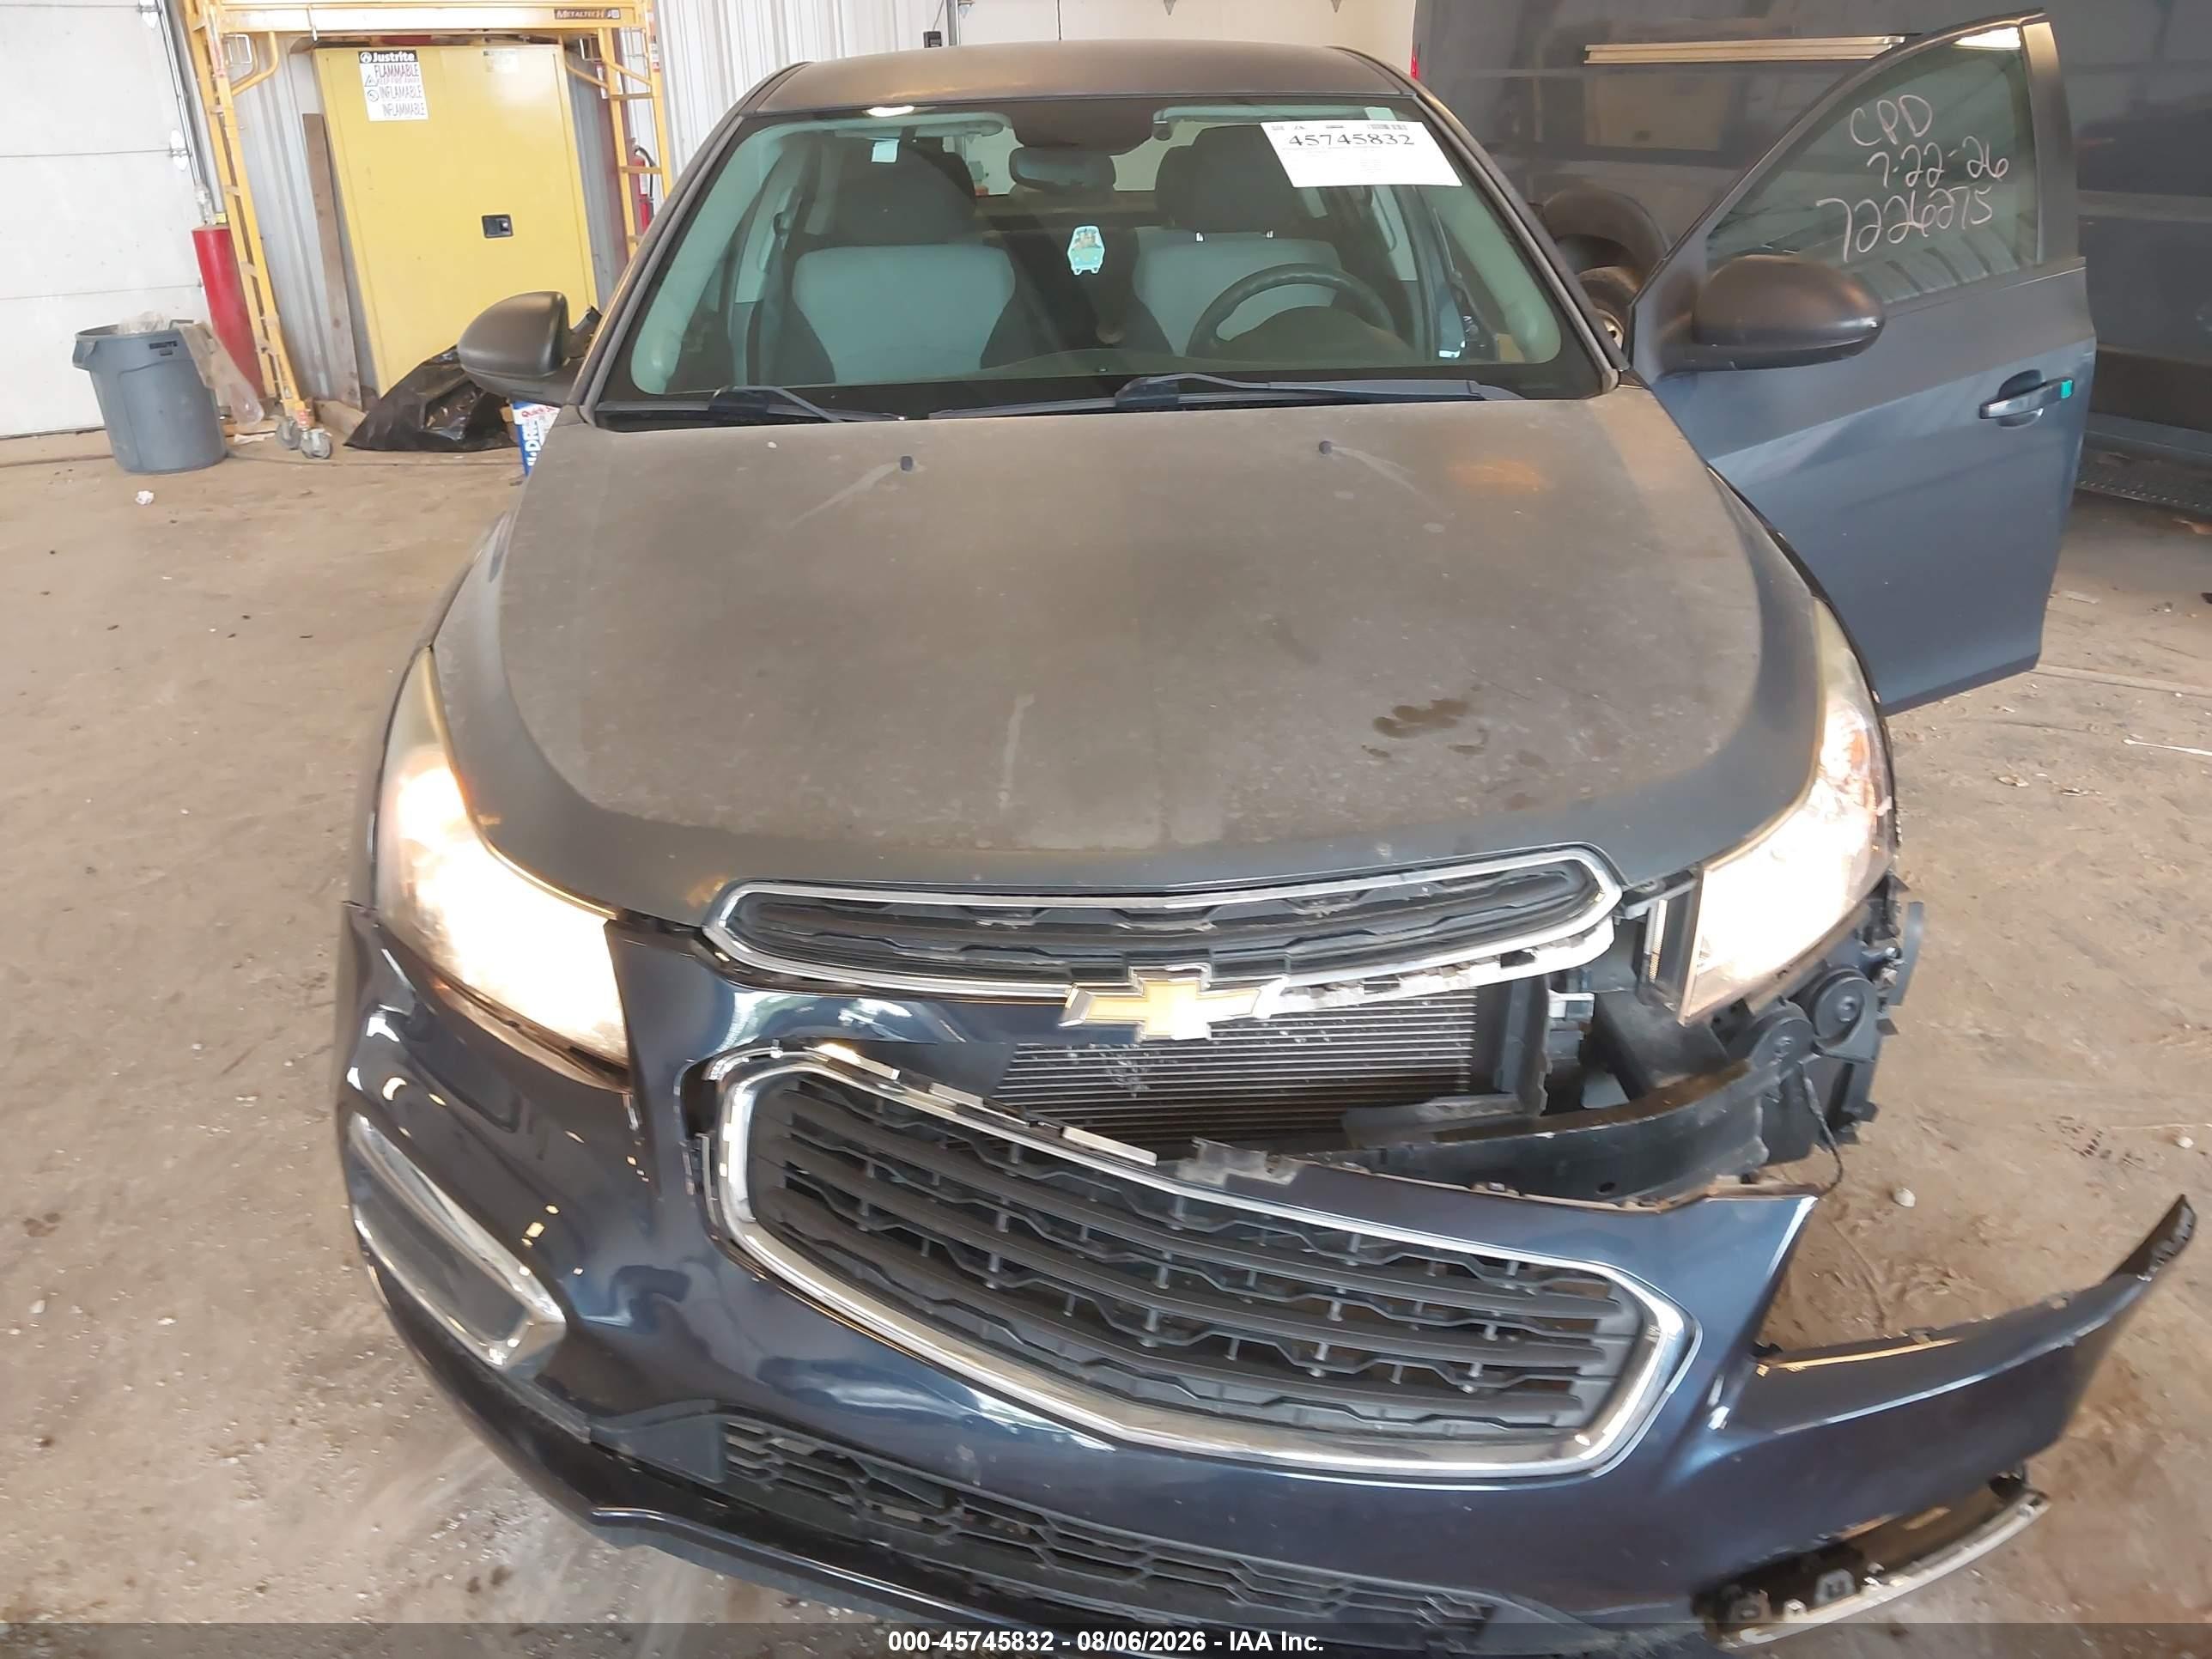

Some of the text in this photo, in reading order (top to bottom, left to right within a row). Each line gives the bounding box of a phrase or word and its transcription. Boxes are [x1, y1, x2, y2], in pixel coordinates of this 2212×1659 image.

[372, 52, 415, 63] Justrite
[374, 64, 420, 77] FLAMMABLE
[1289, 133, 1415, 146] 45745832
[1815, 185, 1993, 263] 7226275
